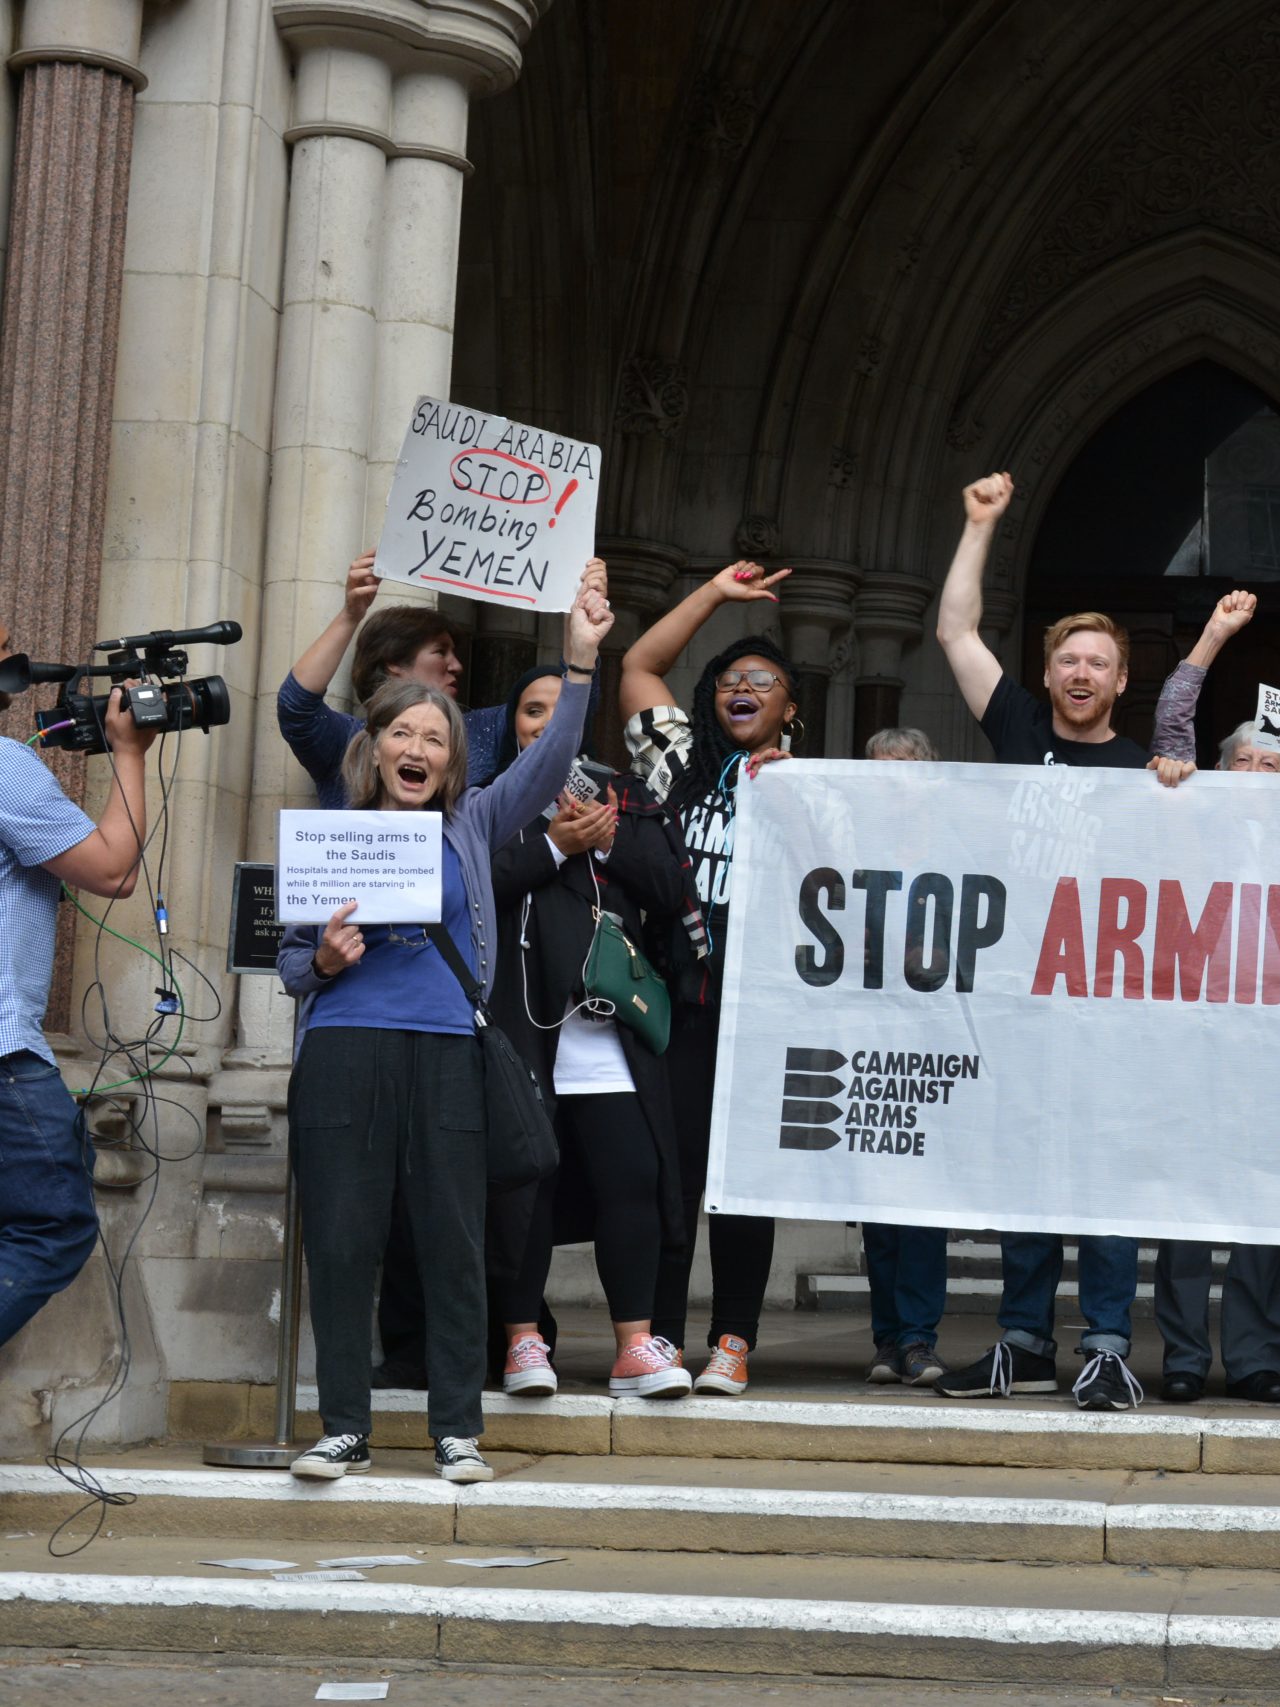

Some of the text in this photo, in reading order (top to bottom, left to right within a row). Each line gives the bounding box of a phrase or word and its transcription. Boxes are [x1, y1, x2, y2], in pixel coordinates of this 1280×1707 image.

[412, 402, 594, 480] SAUDI ARABIA
[452, 457, 545, 503] STOP
[407, 489, 538, 551] Bombing
[408, 530, 549, 591] YEMEN
[295, 831, 427, 845] Stop selling arms to
[326, 850, 396, 861] the Saudis
[286, 880, 310, 888] while
[320, 880, 350, 888] million
[369, 880, 405, 889] starving
[407, 880, 416, 888] in
[287, 866, 329, 876] Hospitals
[331, 867, 348, 875] and
[350, 867, 380, 875] homes
[399, 867, 435, 875] bombed
[286, 894, 308, 905] the
[794, 866, 1007, 993] STOP
[851, 1050, 980, 1079] CAMPAIGN
[847, 1076, 954, 1104] AGAINST
[845, 1102, 917, 1129] ARMS
[845, 1128, 925, 1156] TRADE
